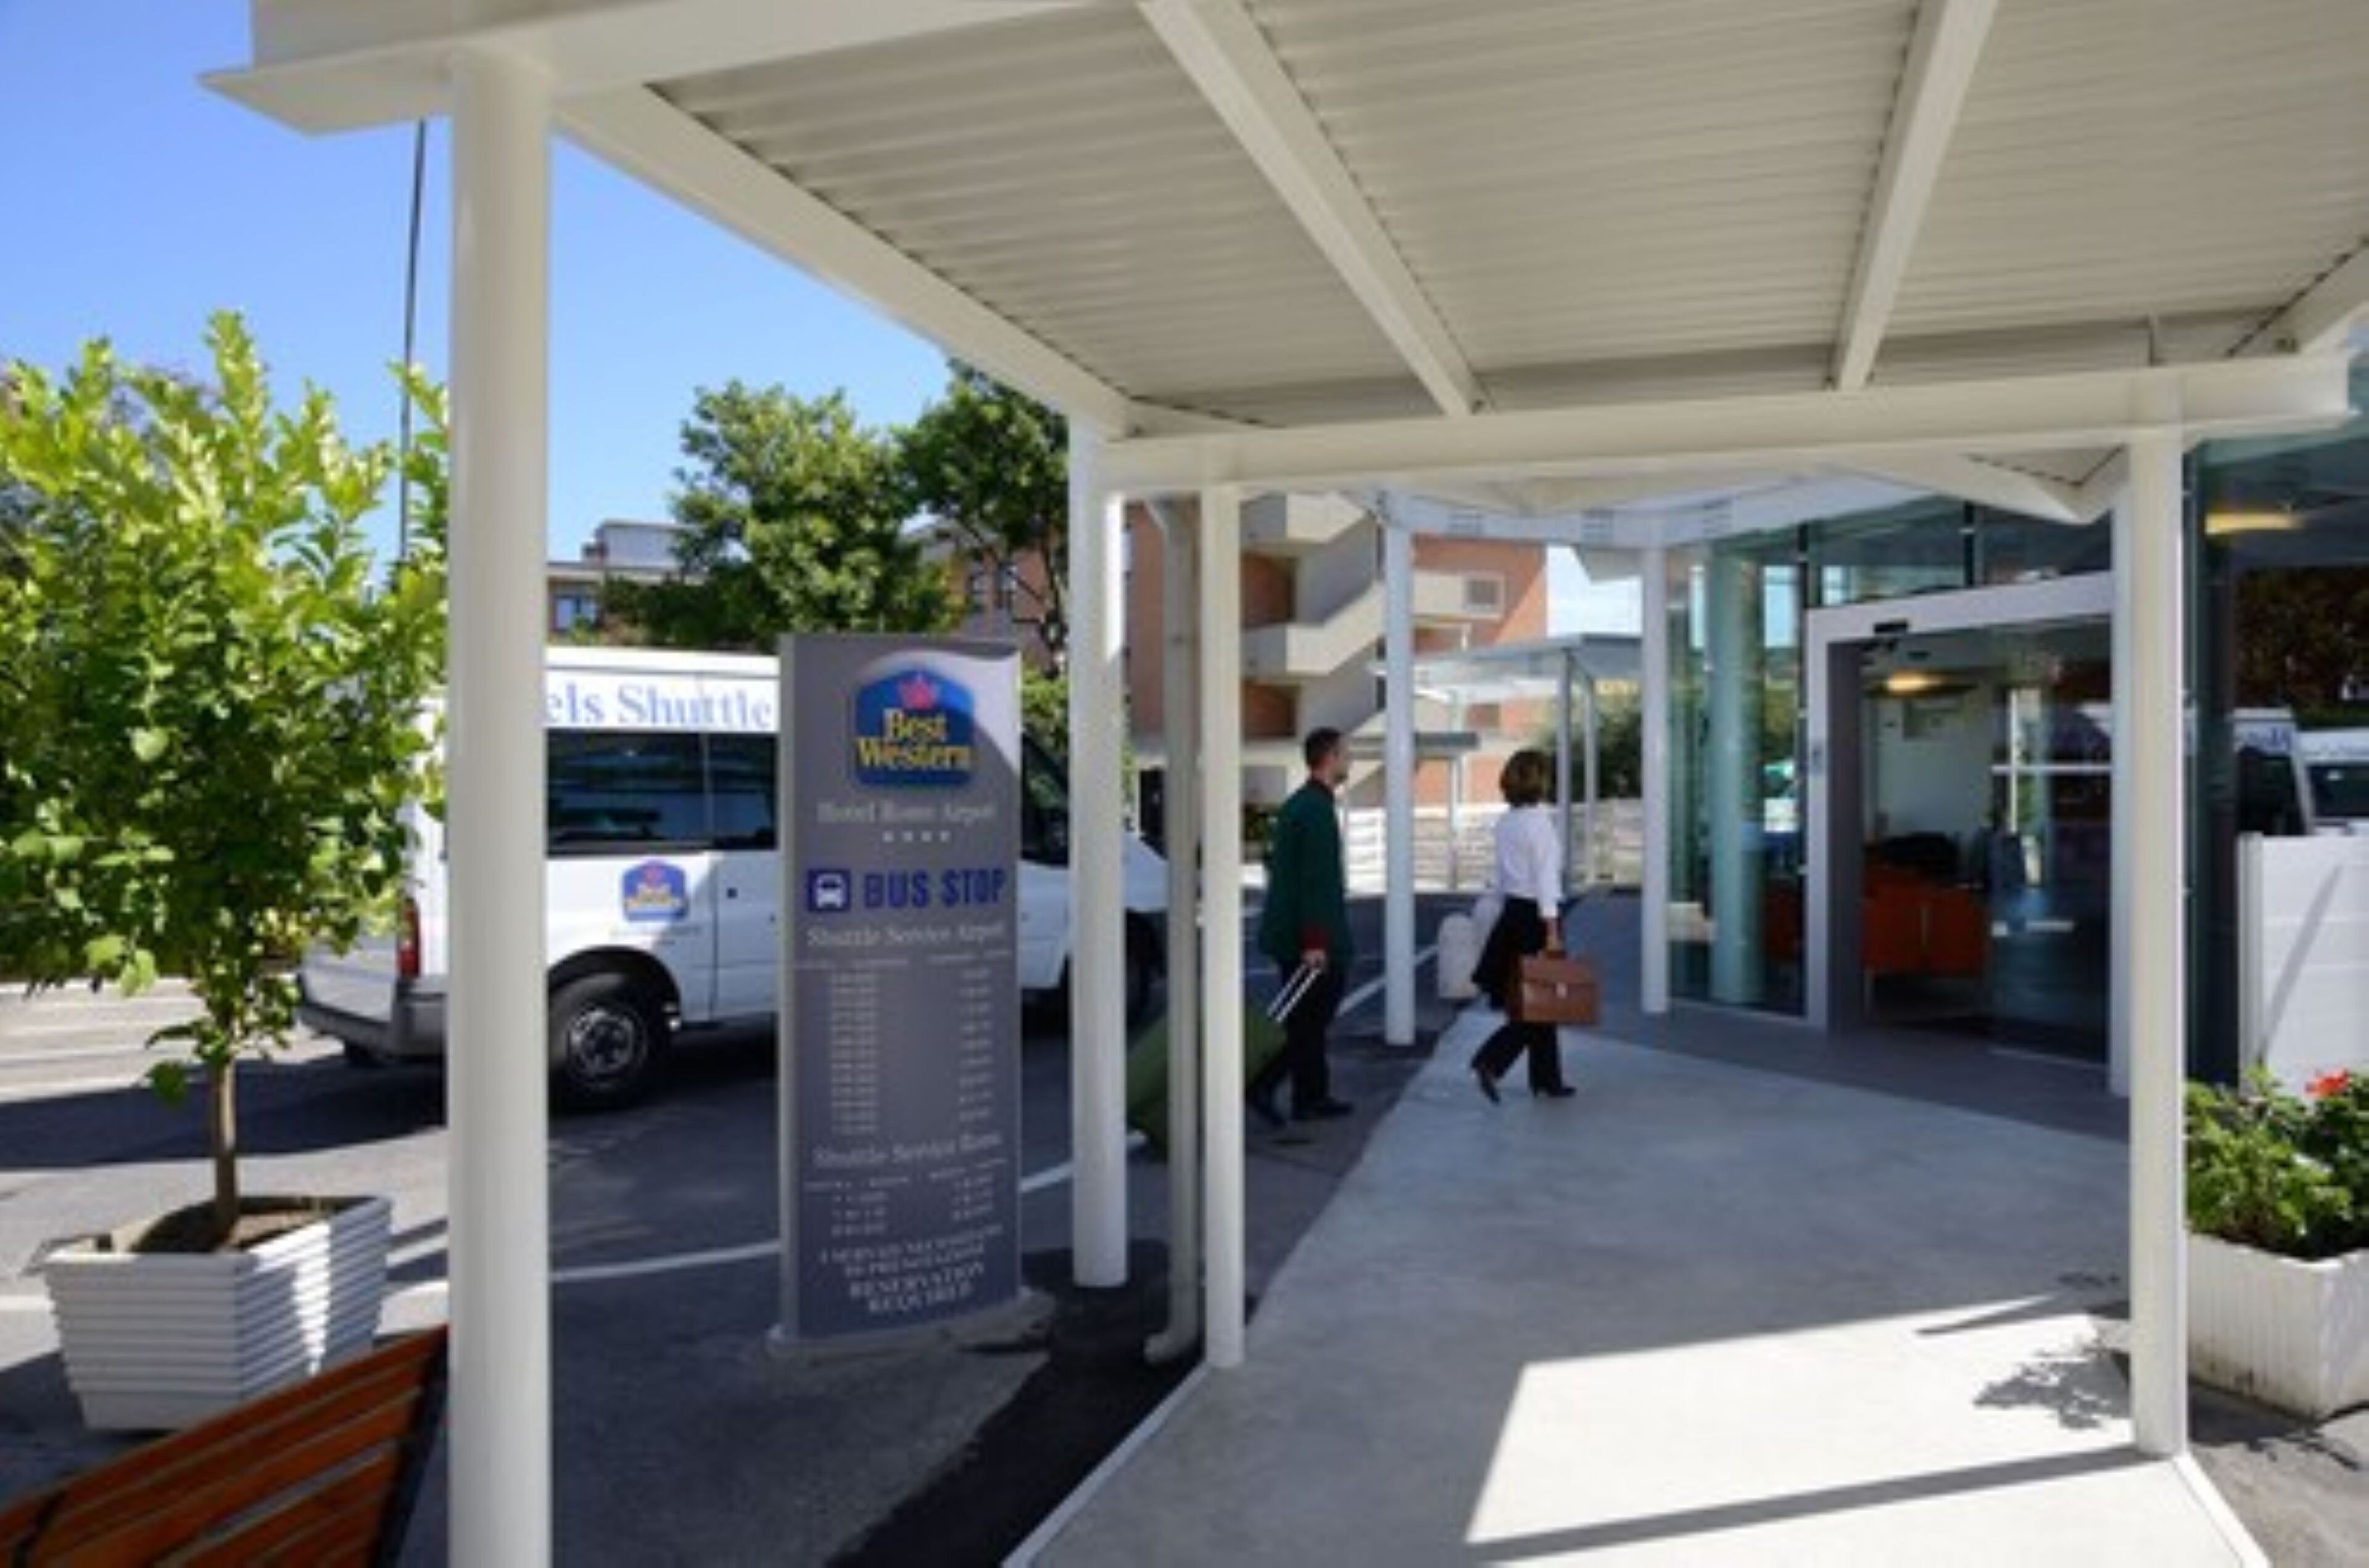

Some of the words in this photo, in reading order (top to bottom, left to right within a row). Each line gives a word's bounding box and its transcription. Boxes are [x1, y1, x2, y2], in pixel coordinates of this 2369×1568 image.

[618, 683, 771, 727] Shuttle
[883, 708, 947, 739] Best
[858, 737, 972, 770] Western
[865, 871, 929, 908] BUS
[942, 869, 1004, 906] STOP
[806, 926, 880, 946] Shuttle
[884, 926, 952, 945] Service
